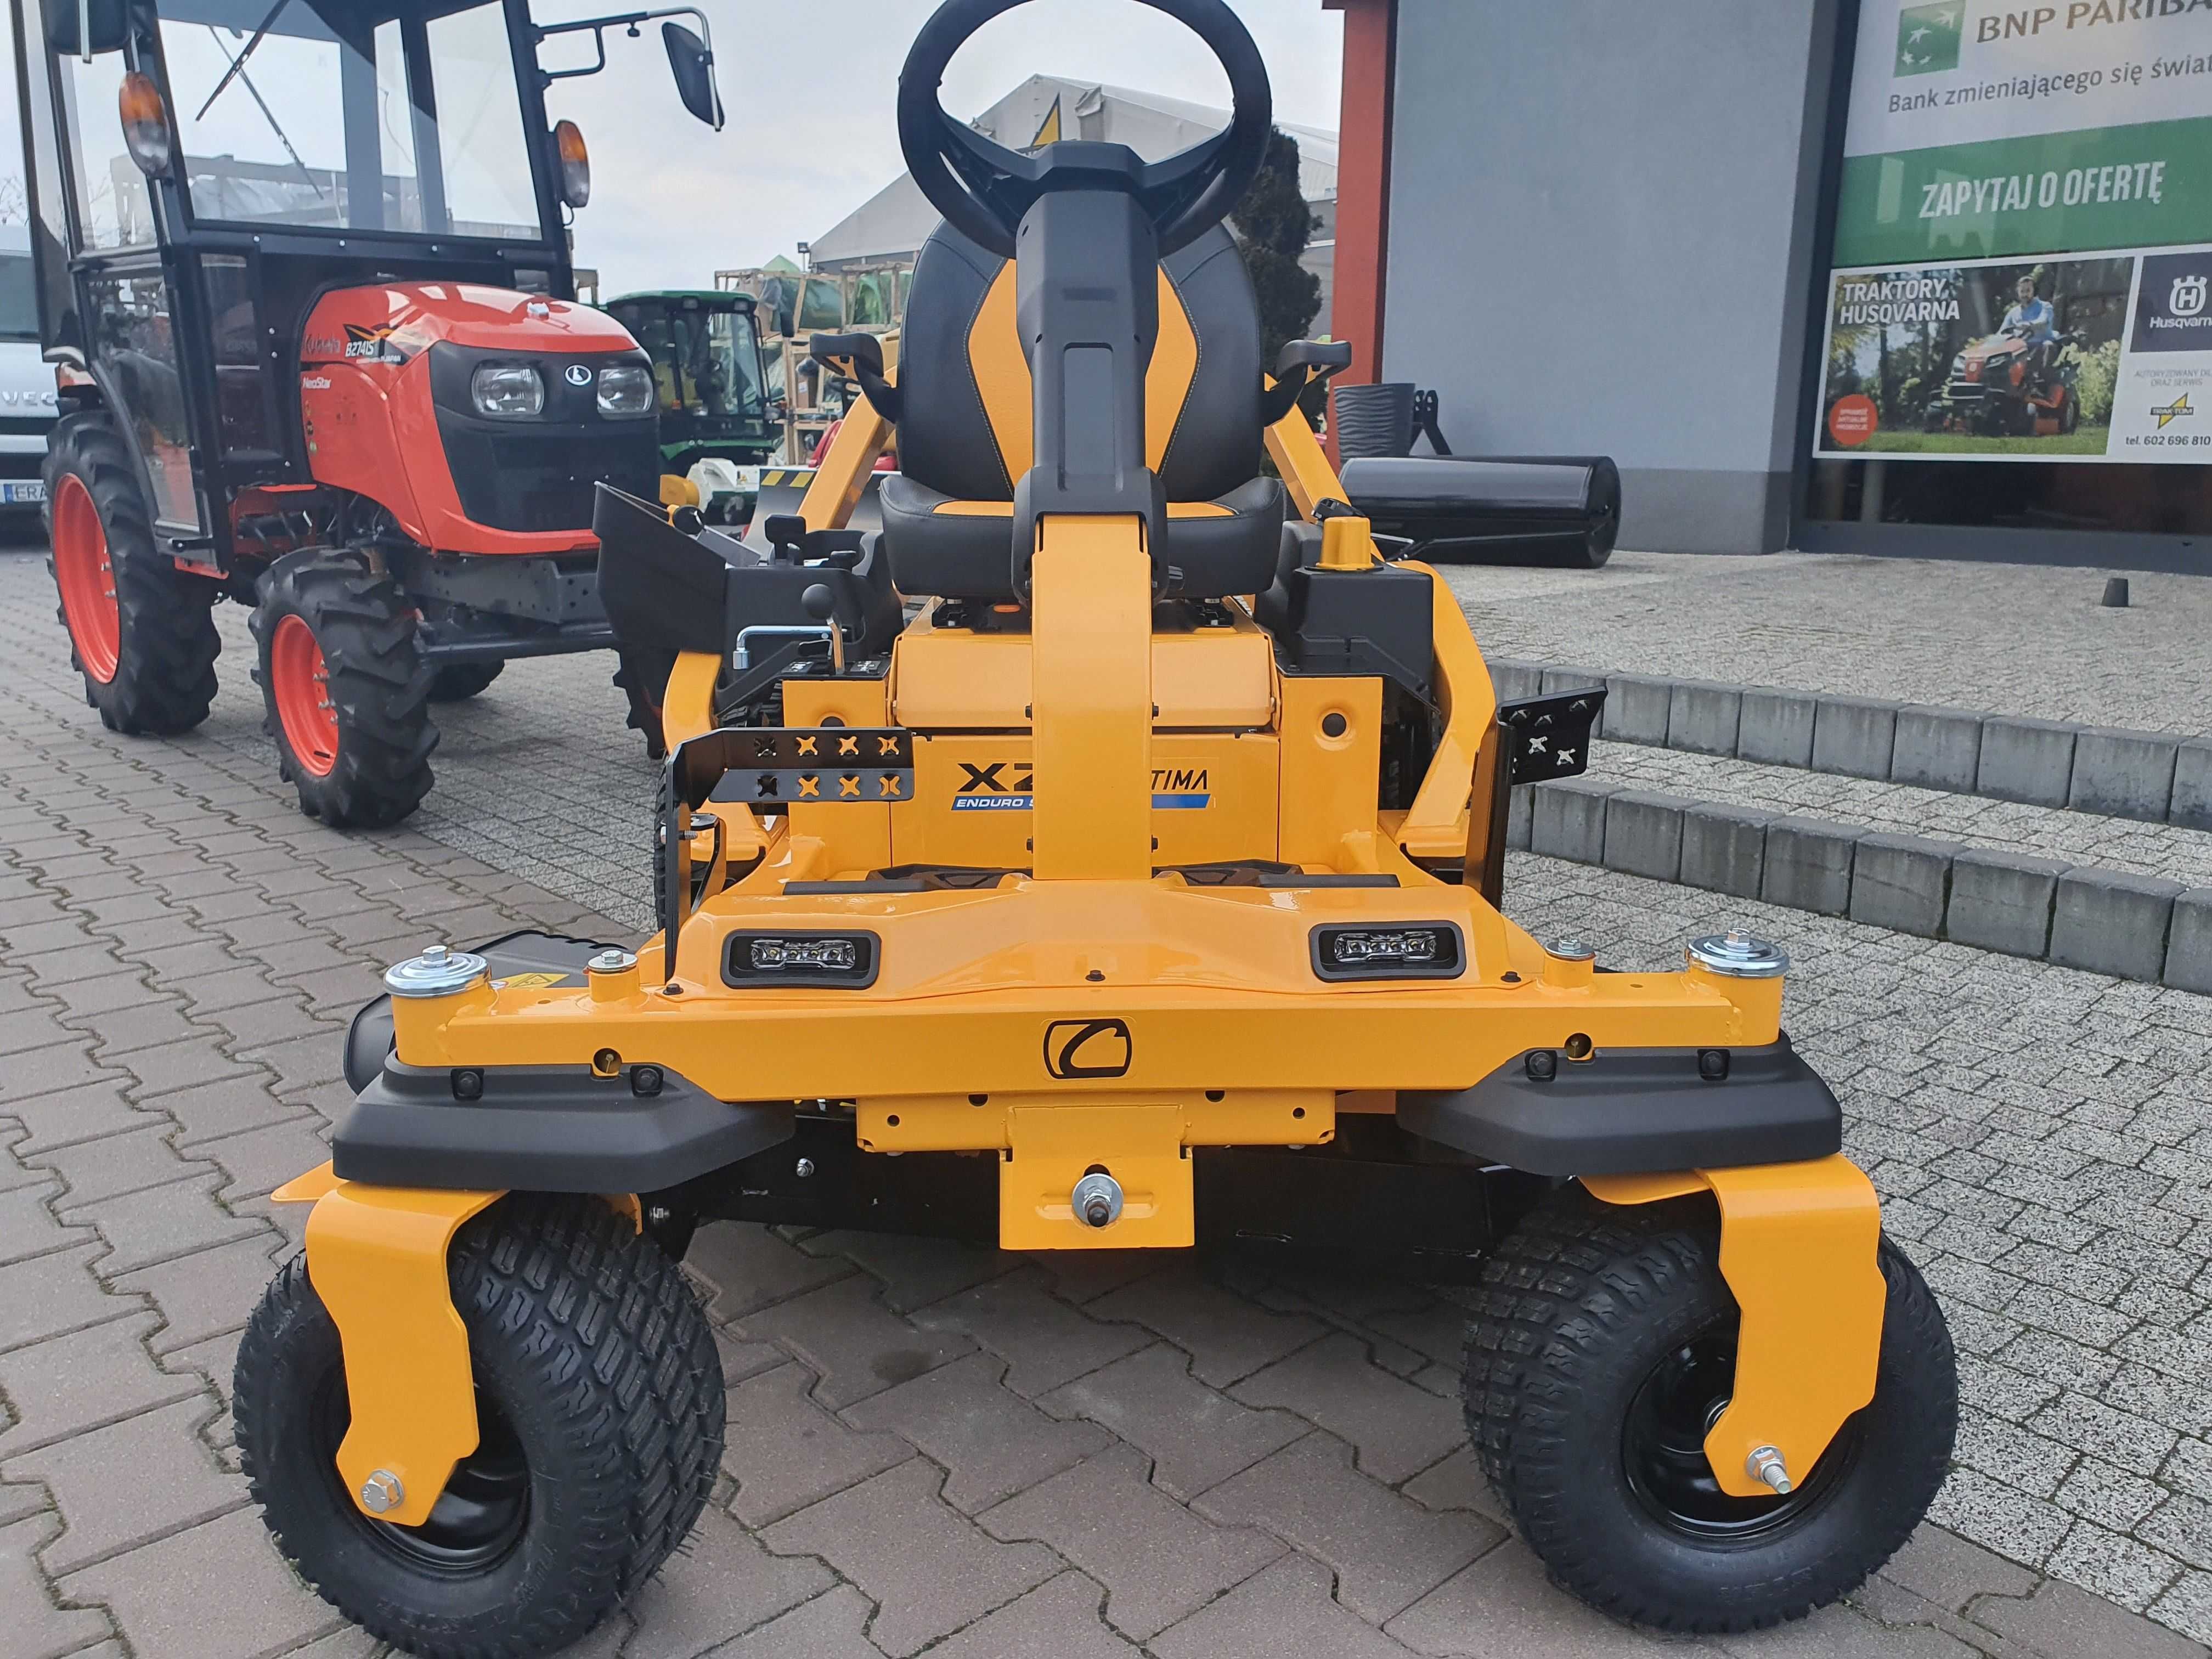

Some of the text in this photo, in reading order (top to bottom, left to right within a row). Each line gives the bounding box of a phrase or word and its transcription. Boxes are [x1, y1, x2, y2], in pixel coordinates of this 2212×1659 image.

[1977, 8, 2056, 43] BNP
[1889, 89, 1938, 113] Bank
[1945, 69, 2102, 105] zmieniającego
[2111, 60, 2143, 86] się
[1919, 161, 2166, 218] ZAPYTAJ O OFERTĘ
[1843, 279, 1946, 302] TRAKTORY
[1839, 300, 1960, 325] HUSQVARNA
[2149, 316, 2212, 329] Husqvarn
[2126, 436, 2211, 445] tel. 602 696 810
[956, 799, 1024, 808] ENDURO
